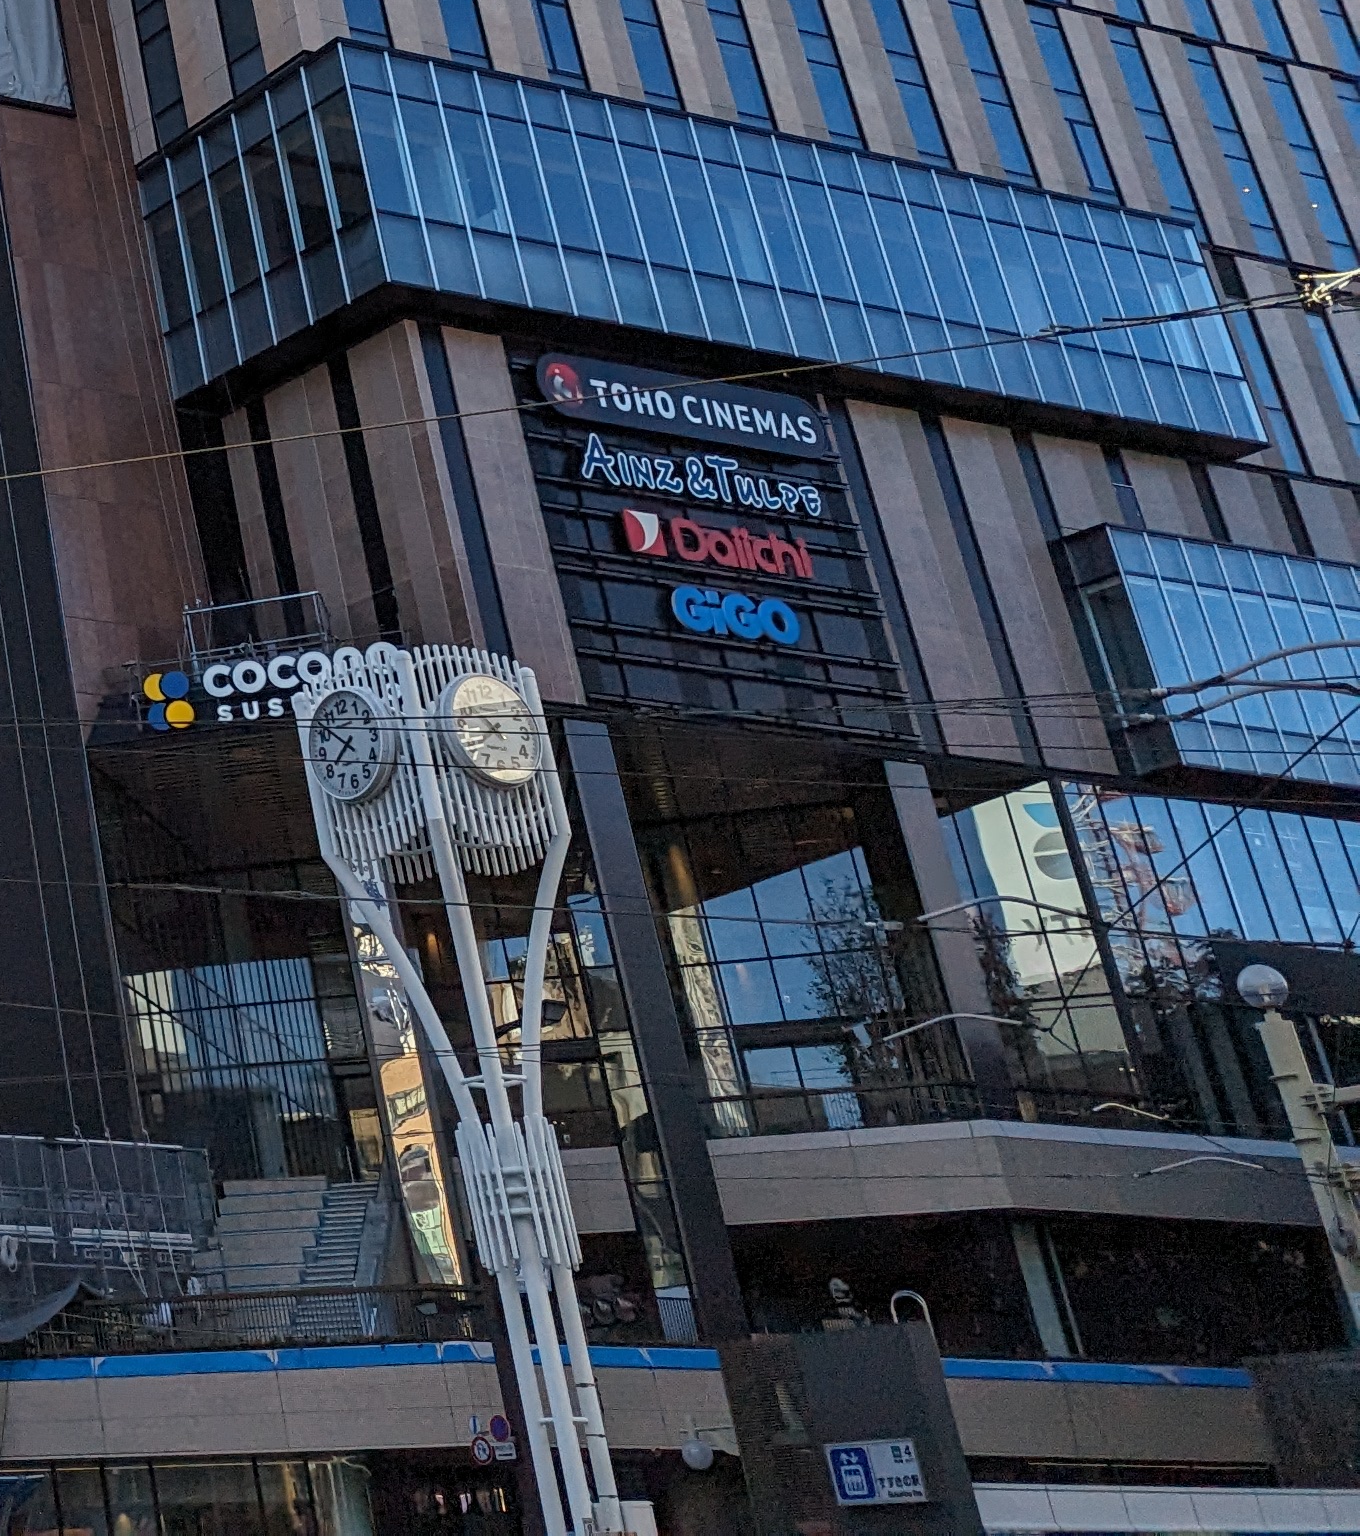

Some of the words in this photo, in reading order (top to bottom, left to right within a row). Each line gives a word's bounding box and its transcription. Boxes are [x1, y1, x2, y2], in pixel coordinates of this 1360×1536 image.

[589, 378, 675, 420] TOHO
[682, 395, 818, 444] CINEMAS
[670, 516, 815, 579] Daiichi
